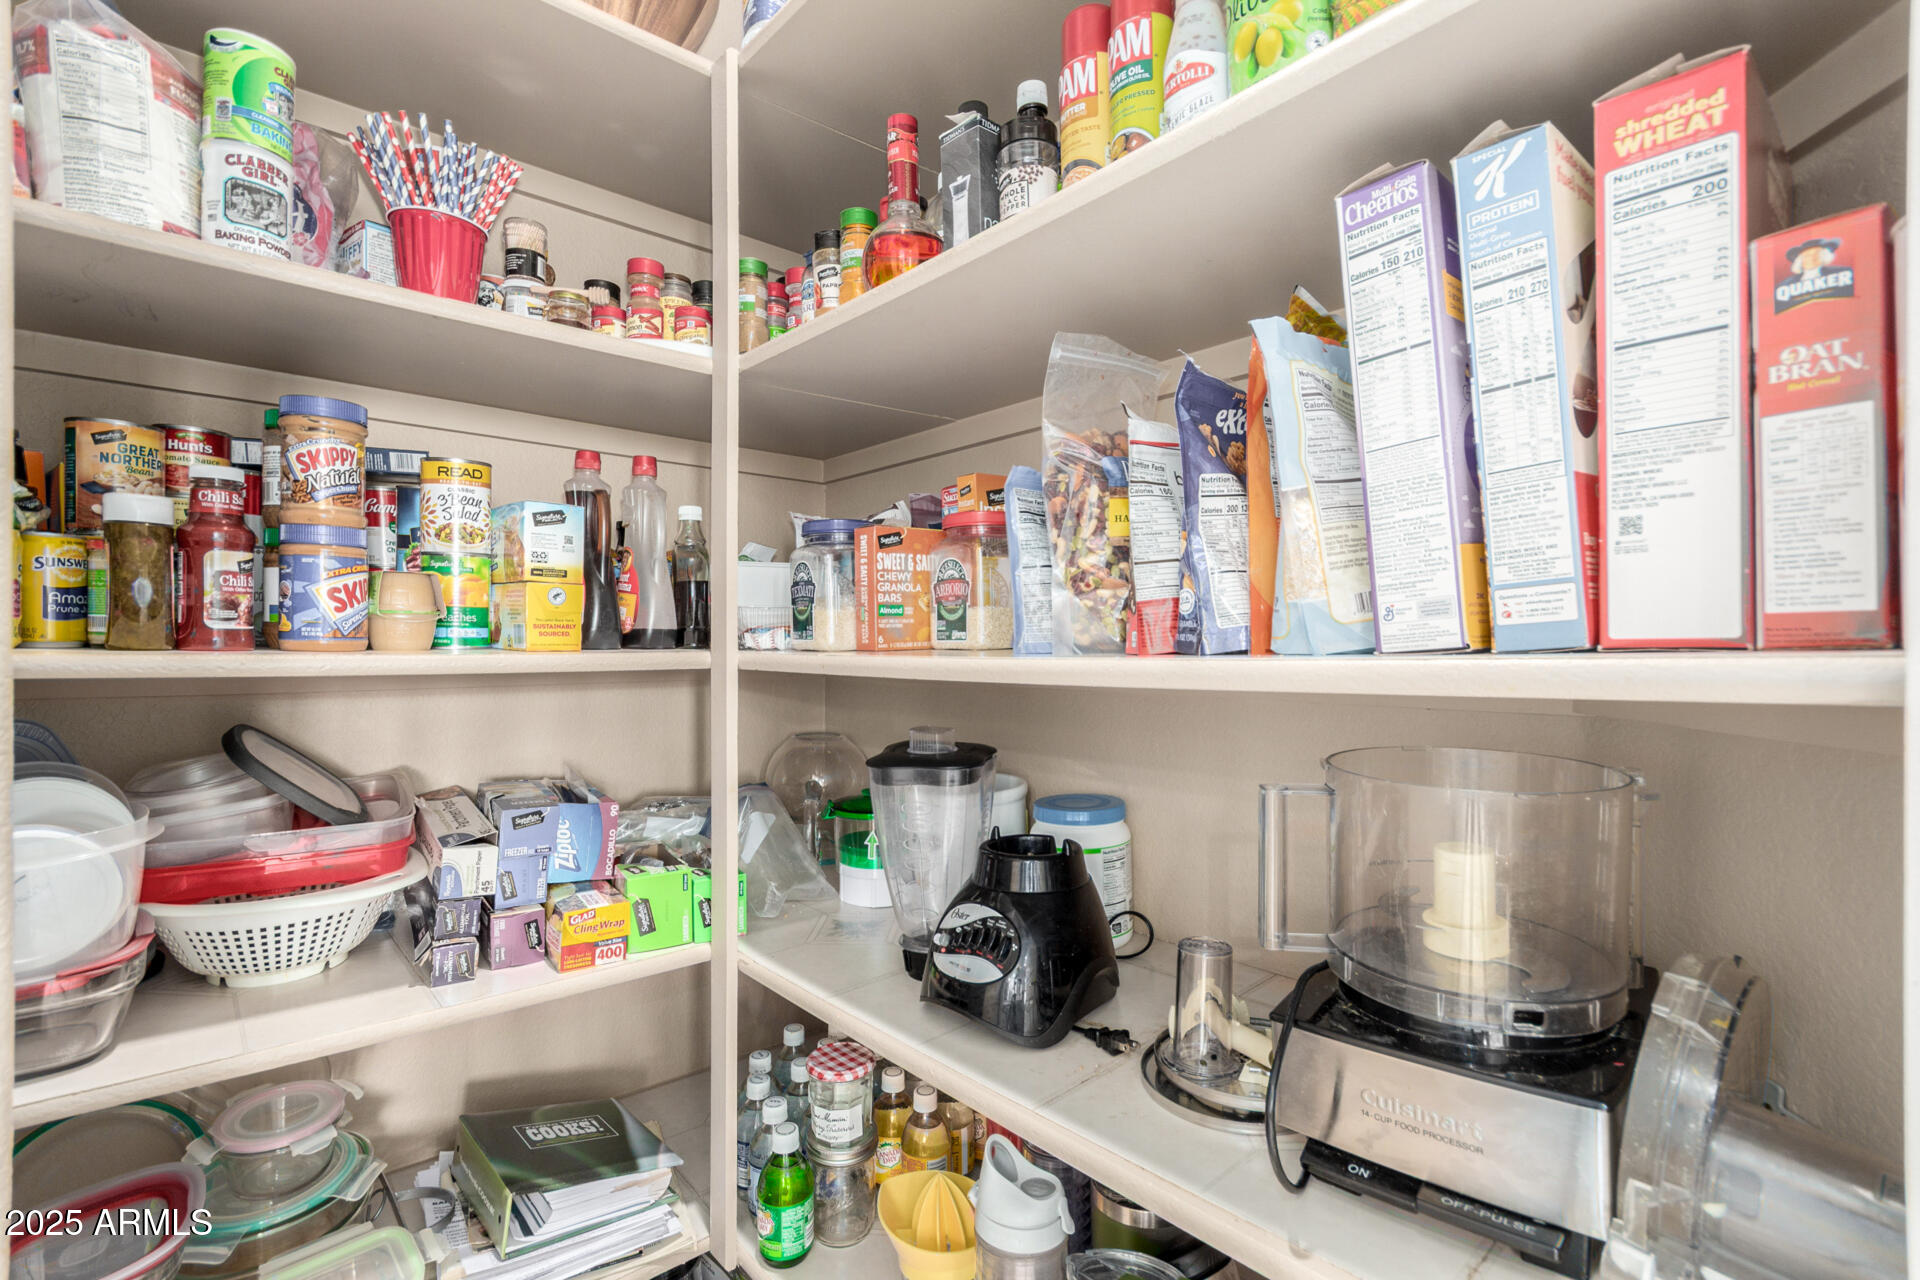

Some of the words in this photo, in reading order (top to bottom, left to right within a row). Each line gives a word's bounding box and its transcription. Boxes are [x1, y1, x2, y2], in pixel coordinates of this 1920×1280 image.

[1615, 87, 1727, 139] shredded
[981, 118, 1000, 133] TIDMA
[1613, 104, 1729, 158] WHEAT
[251, 121, 293, 152] BAKIN
[1472, 146, 1507, 164] SPECIAL
[1613, 157, 1680, 184] Nutrition
[1685, 143, 1729, 162] Facts
[225, 154, 289, 187] CLABBER
[242, 167, 277, 187] GIRL
[1473, 138, 1528, 202] K
[1371, 184, 1391, 199] Multi
[1394, 174, 1417, 189] Grain
[1344, 182, 1418, 226] Cheerios
[1613, 199, 1667, 222] Calories
[1692, 177, 1728, 198] 200
[1471, 195, 1534, 227] PROTEIN
[1347, 219, 1389, 242] Nutrition
[1392, 207, 1421, 224] Facts
[215, 230, 255, 244] BAKING
[1350, 264, 1379, 282] Calories
[1381, 255, 1400, 270] 150
[1403, 246, 1423, 262] 210
[1471, 252, 1514, 271] Nutrition
[1517, 242, 1545, 256] Facts
[1473, 296, 1503, 311] Calories
[1508, 286, 1526, 300] 210
[1530, 279, 1549, 293] 270
[1776, 269, 1854, 302] QUAKER
[1780, 337, 1848, 365] OAT
[1768, 351, 1865, 385] BRAN
[117, 443, 159, 459] GREAT
[295, 447, 356, 473] SKIPPY
[99, 452, 163, 471] NORTHER
[125, 466, 154, 477] Beans
[306, 467, 361, 493] Natural
[437, 466, 483, 479] READ
[198, 490, 230, 503] Chili
[33, 556, 88, 570] SUNSWE
[877, 552, 904, 571] SWEET
[220, 575, 247, 587] Chili
[877, 572, 913, 581] CHEWY
[877, 582, 922, 593] GRANOLA
[935, 582, 969, 599] ARBORIO
[877, 593, 902, 603] BARS
[48, 604, 79, 614] Prune
[533, 623, 576, 631] SUSTAINABLY
[610, 804, 619, 817] 90
[504, 847, 528, 857] FREEZER
[554, 816, 580, 872] Ziploc
[605, 829, 617, 876] BOCADILLO
[481, 880, 490, 892] 45
[570, 910, 596, 925] GLAD
[951, 908, 970, 920] Oster
[574, 924, 599, 935] Cling
[600, 920, 625, 929] Wrap
[598, 945, 622, 960] 400
[1360, 1087, 1484, 1141] Cuisinart
[525, 1118, 604, 1143] COOKS!
[1394, 1119, 1421, 1135] FOOD
[1422, 1128, 1484, 1155] PROCESSOR
[883, 1156, 897, 1165] DRY
[1347, 1163, 1371, 1179] ON
[1440, 1196, 1537, 1236] OFF-PULSE
